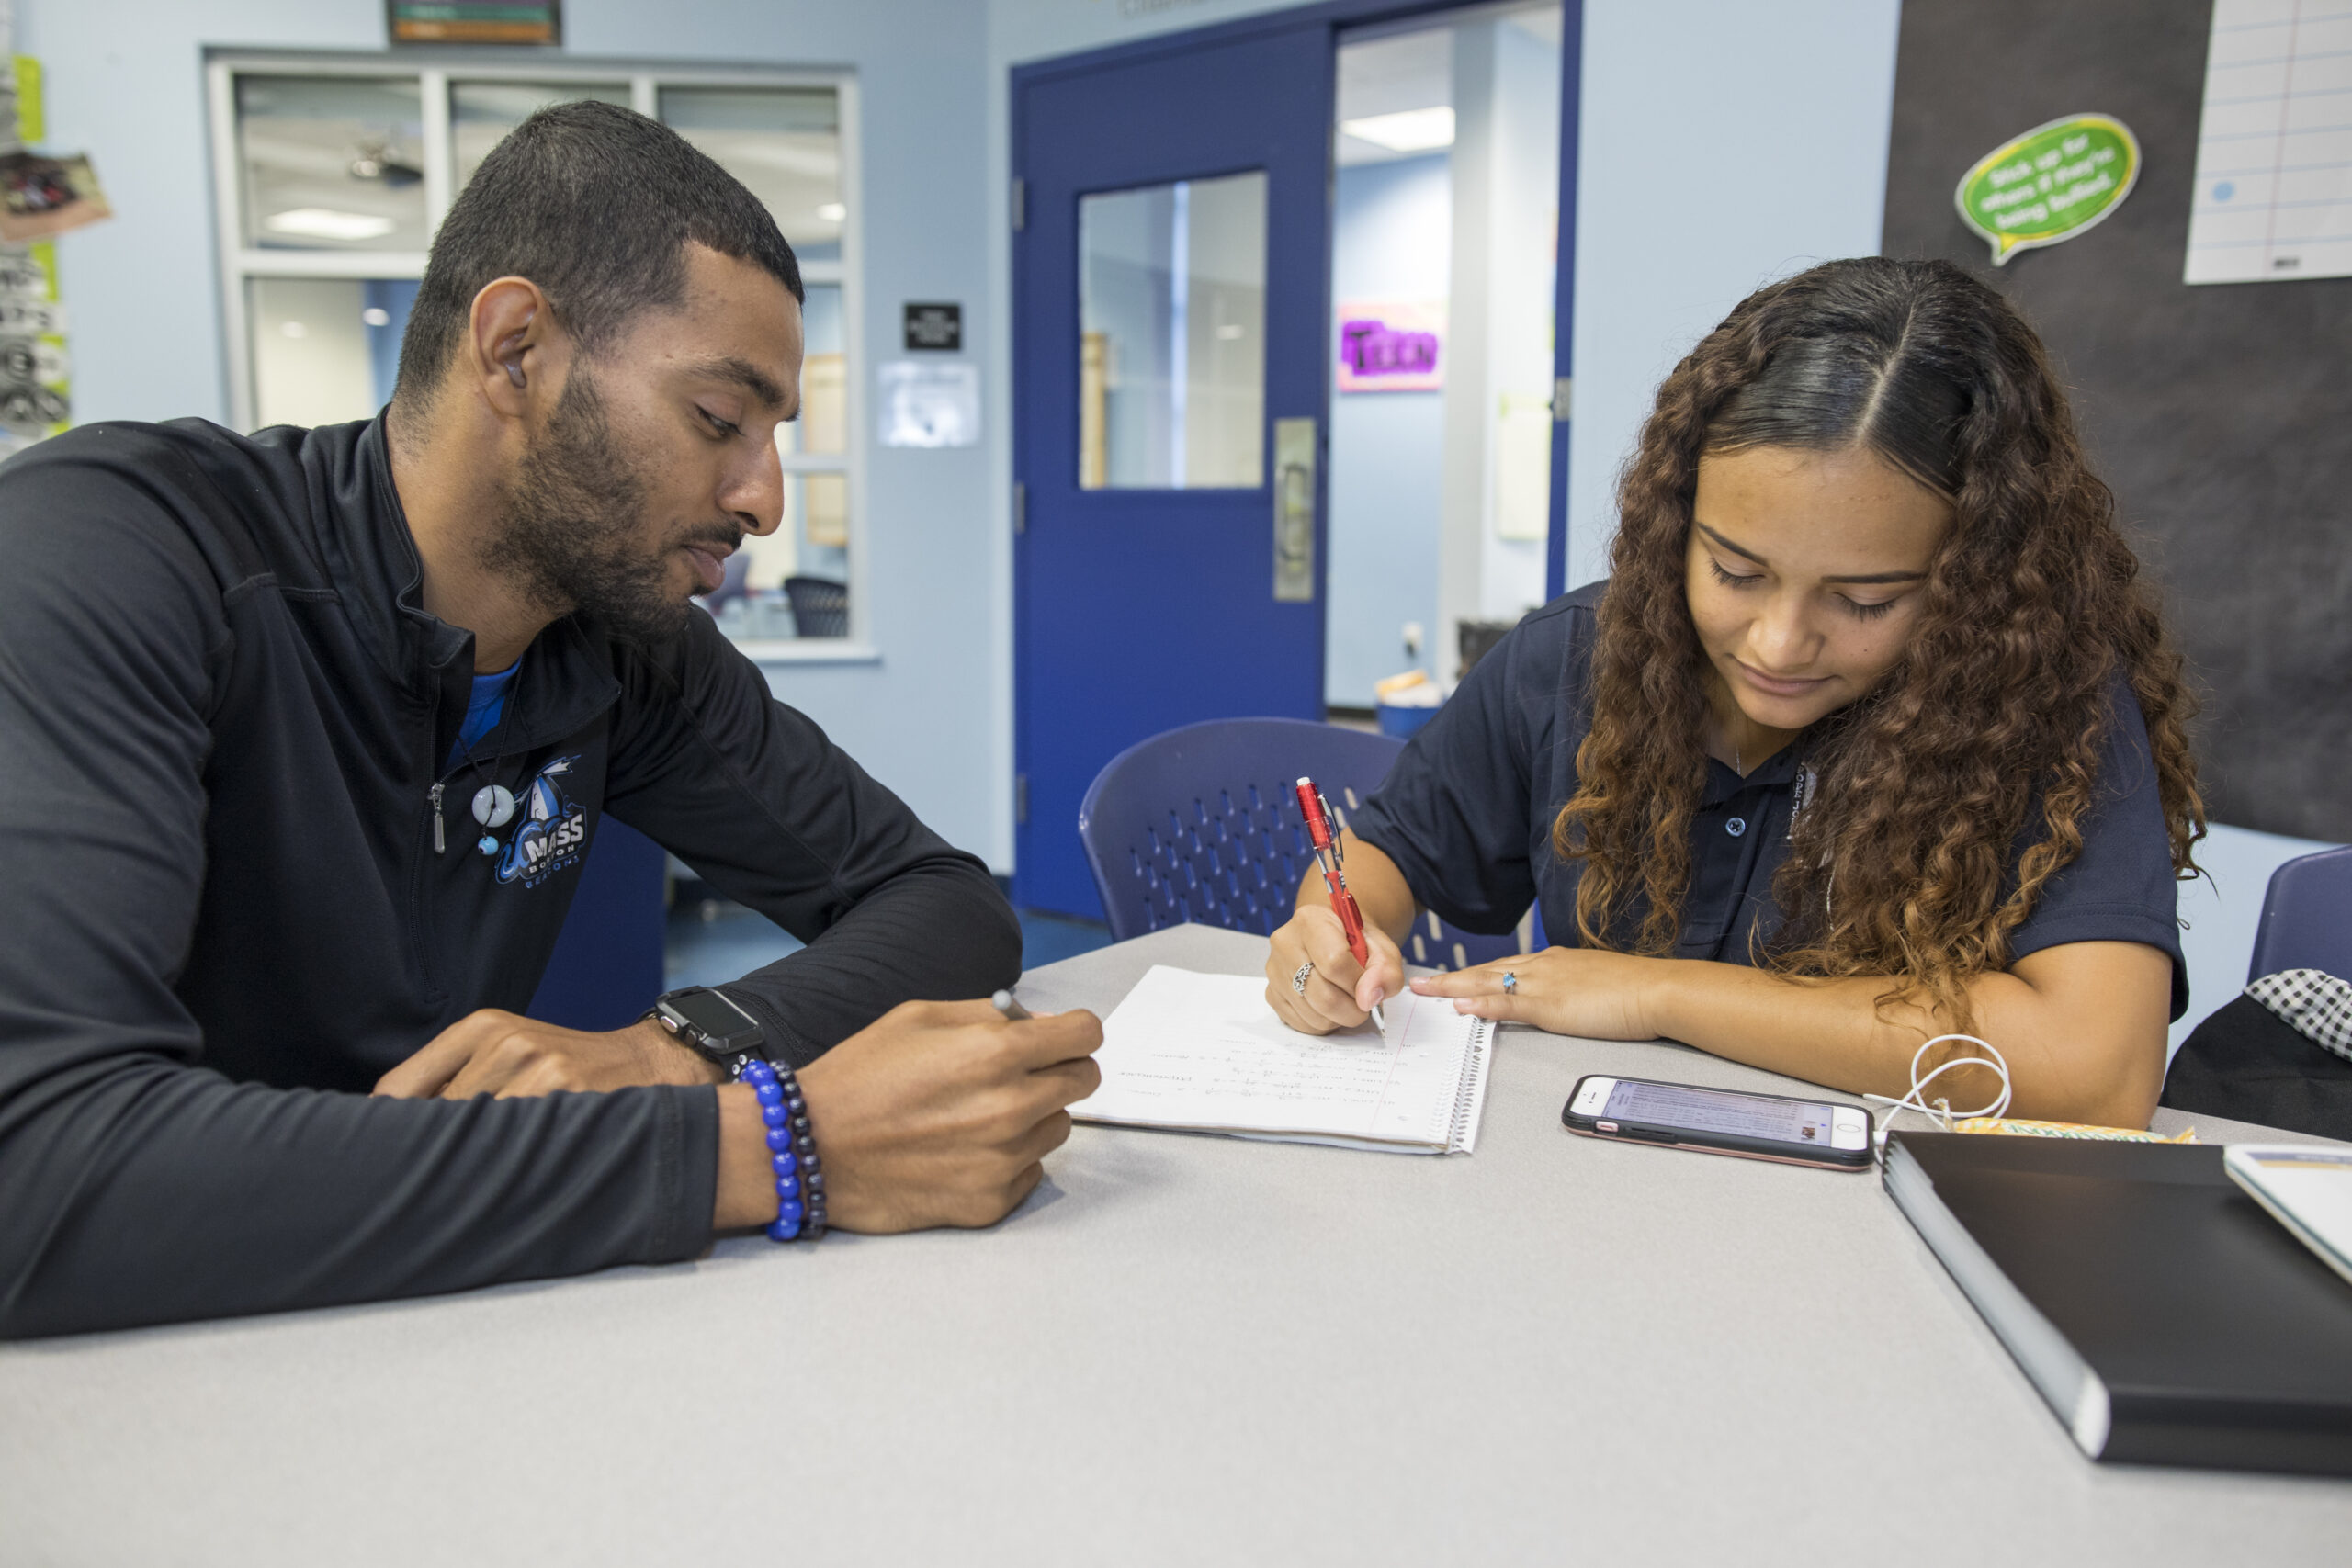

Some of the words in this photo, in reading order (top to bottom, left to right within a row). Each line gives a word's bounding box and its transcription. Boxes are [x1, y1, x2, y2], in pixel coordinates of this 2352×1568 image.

[1989, 161, 2033, 188] Stick
[2035, 149, 2063, 171] up
[2062, 133, 2089, 157] for
[1981, 186, 2036, 212] others
[1995, 202, 2049, 229] being
[525, 813, 584, 863] MASS
